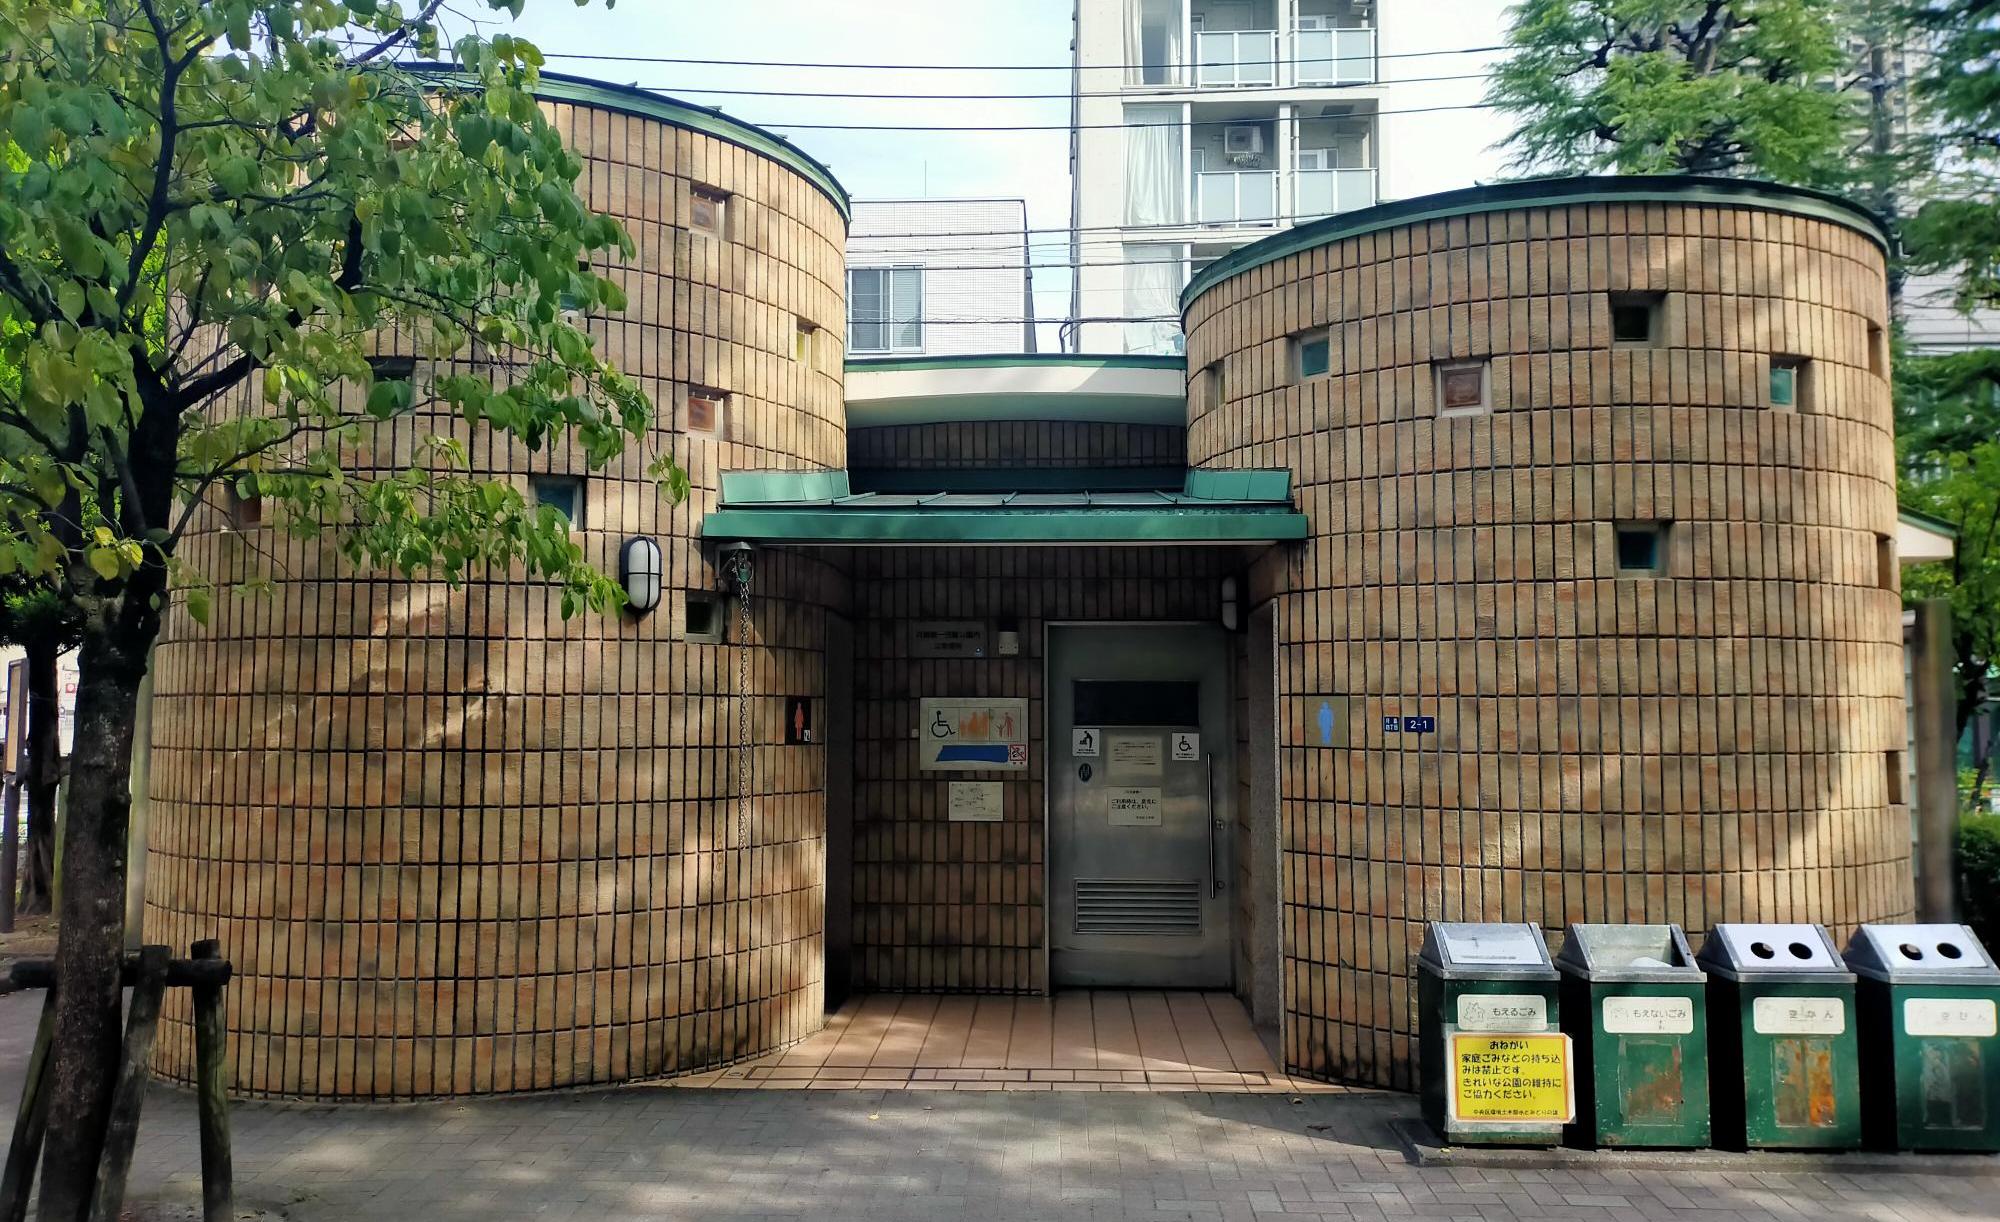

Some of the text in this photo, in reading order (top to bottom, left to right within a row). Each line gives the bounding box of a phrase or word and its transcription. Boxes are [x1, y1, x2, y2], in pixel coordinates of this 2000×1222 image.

[1410, 720, 1427, 729] 2-1
[1492, 1007, 1537, 1017] もえるごみ
[1633, 1009, 1687, 1018] もえないごみ
[1489, 1041, 1529, 1050] おねがい
[1462, 1053, 1561, 1064] 家庭ごみなどの持ち込
[1462, 1065, 1526, 1075] みは禁止です。
[1463, 1078, 1561, 1088] きれいな公園の維持に
[1463, 1090, 1538, 1099] ご協力ください。
